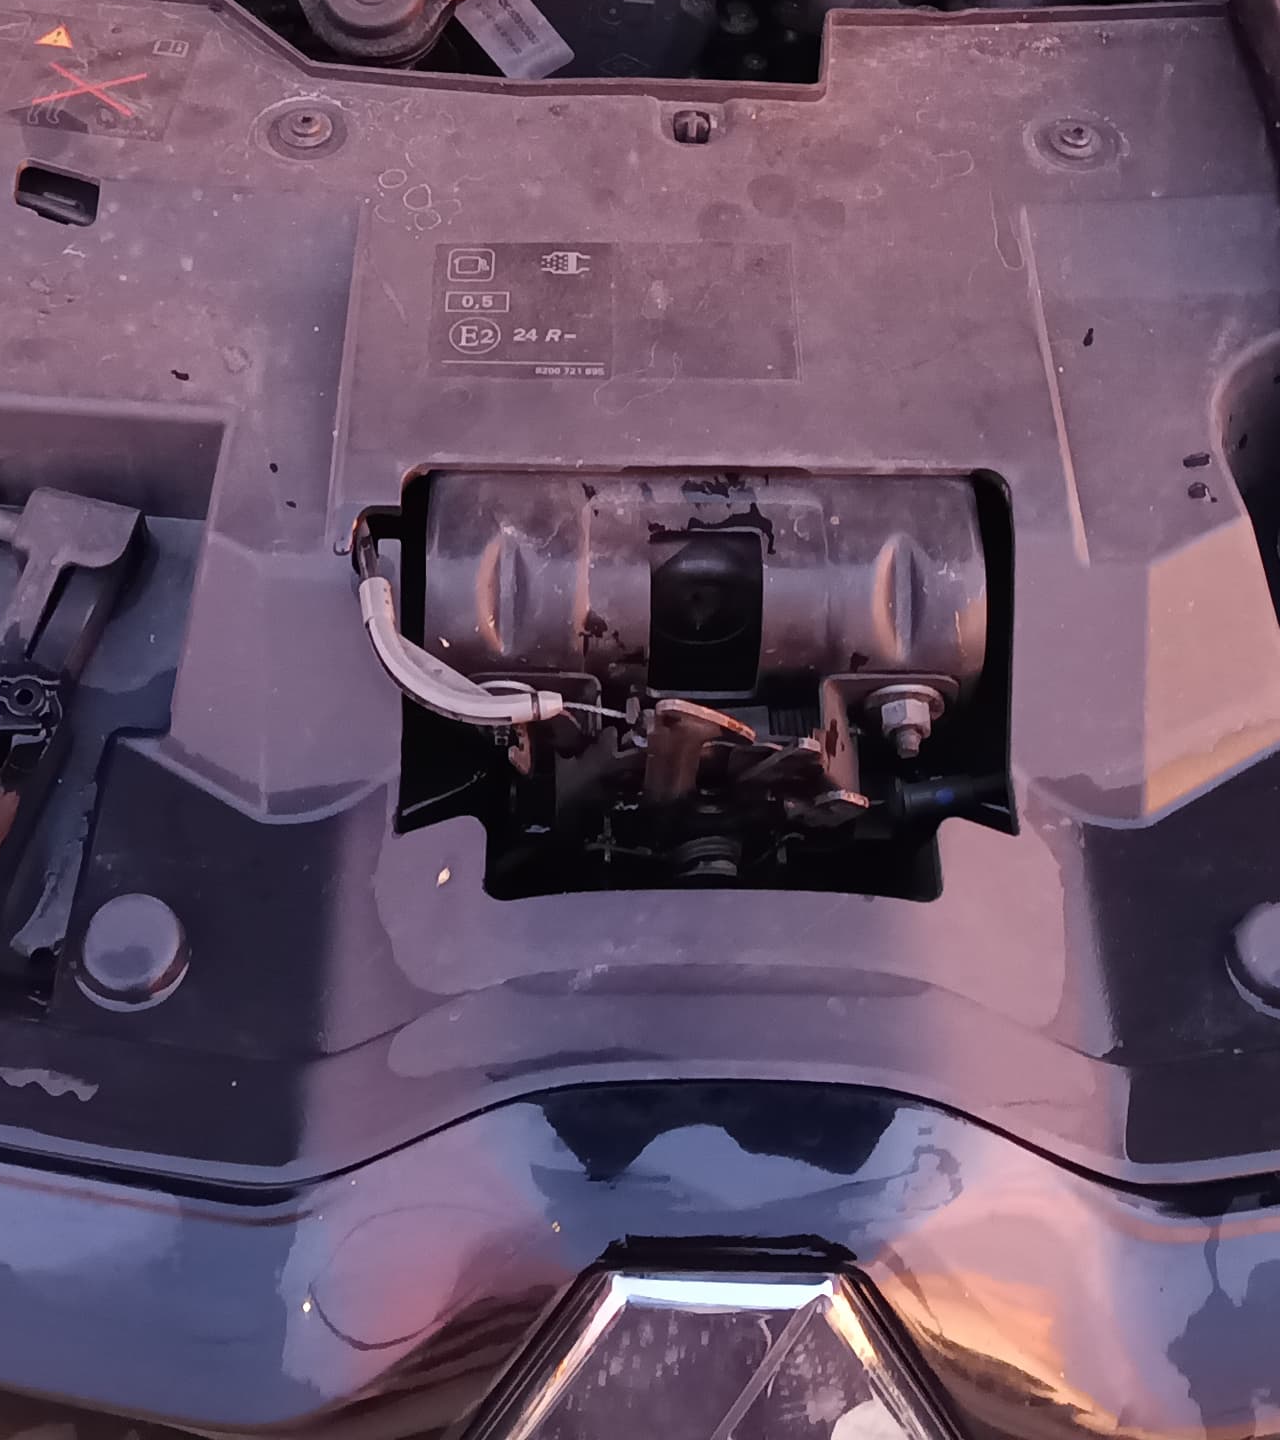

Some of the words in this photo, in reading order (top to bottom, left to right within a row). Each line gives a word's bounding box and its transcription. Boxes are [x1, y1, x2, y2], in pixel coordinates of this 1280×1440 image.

[461, 295, 493, 309] 0,5
[458, 325, 495, 346] E2
[513, 328, 538, 342] 24
